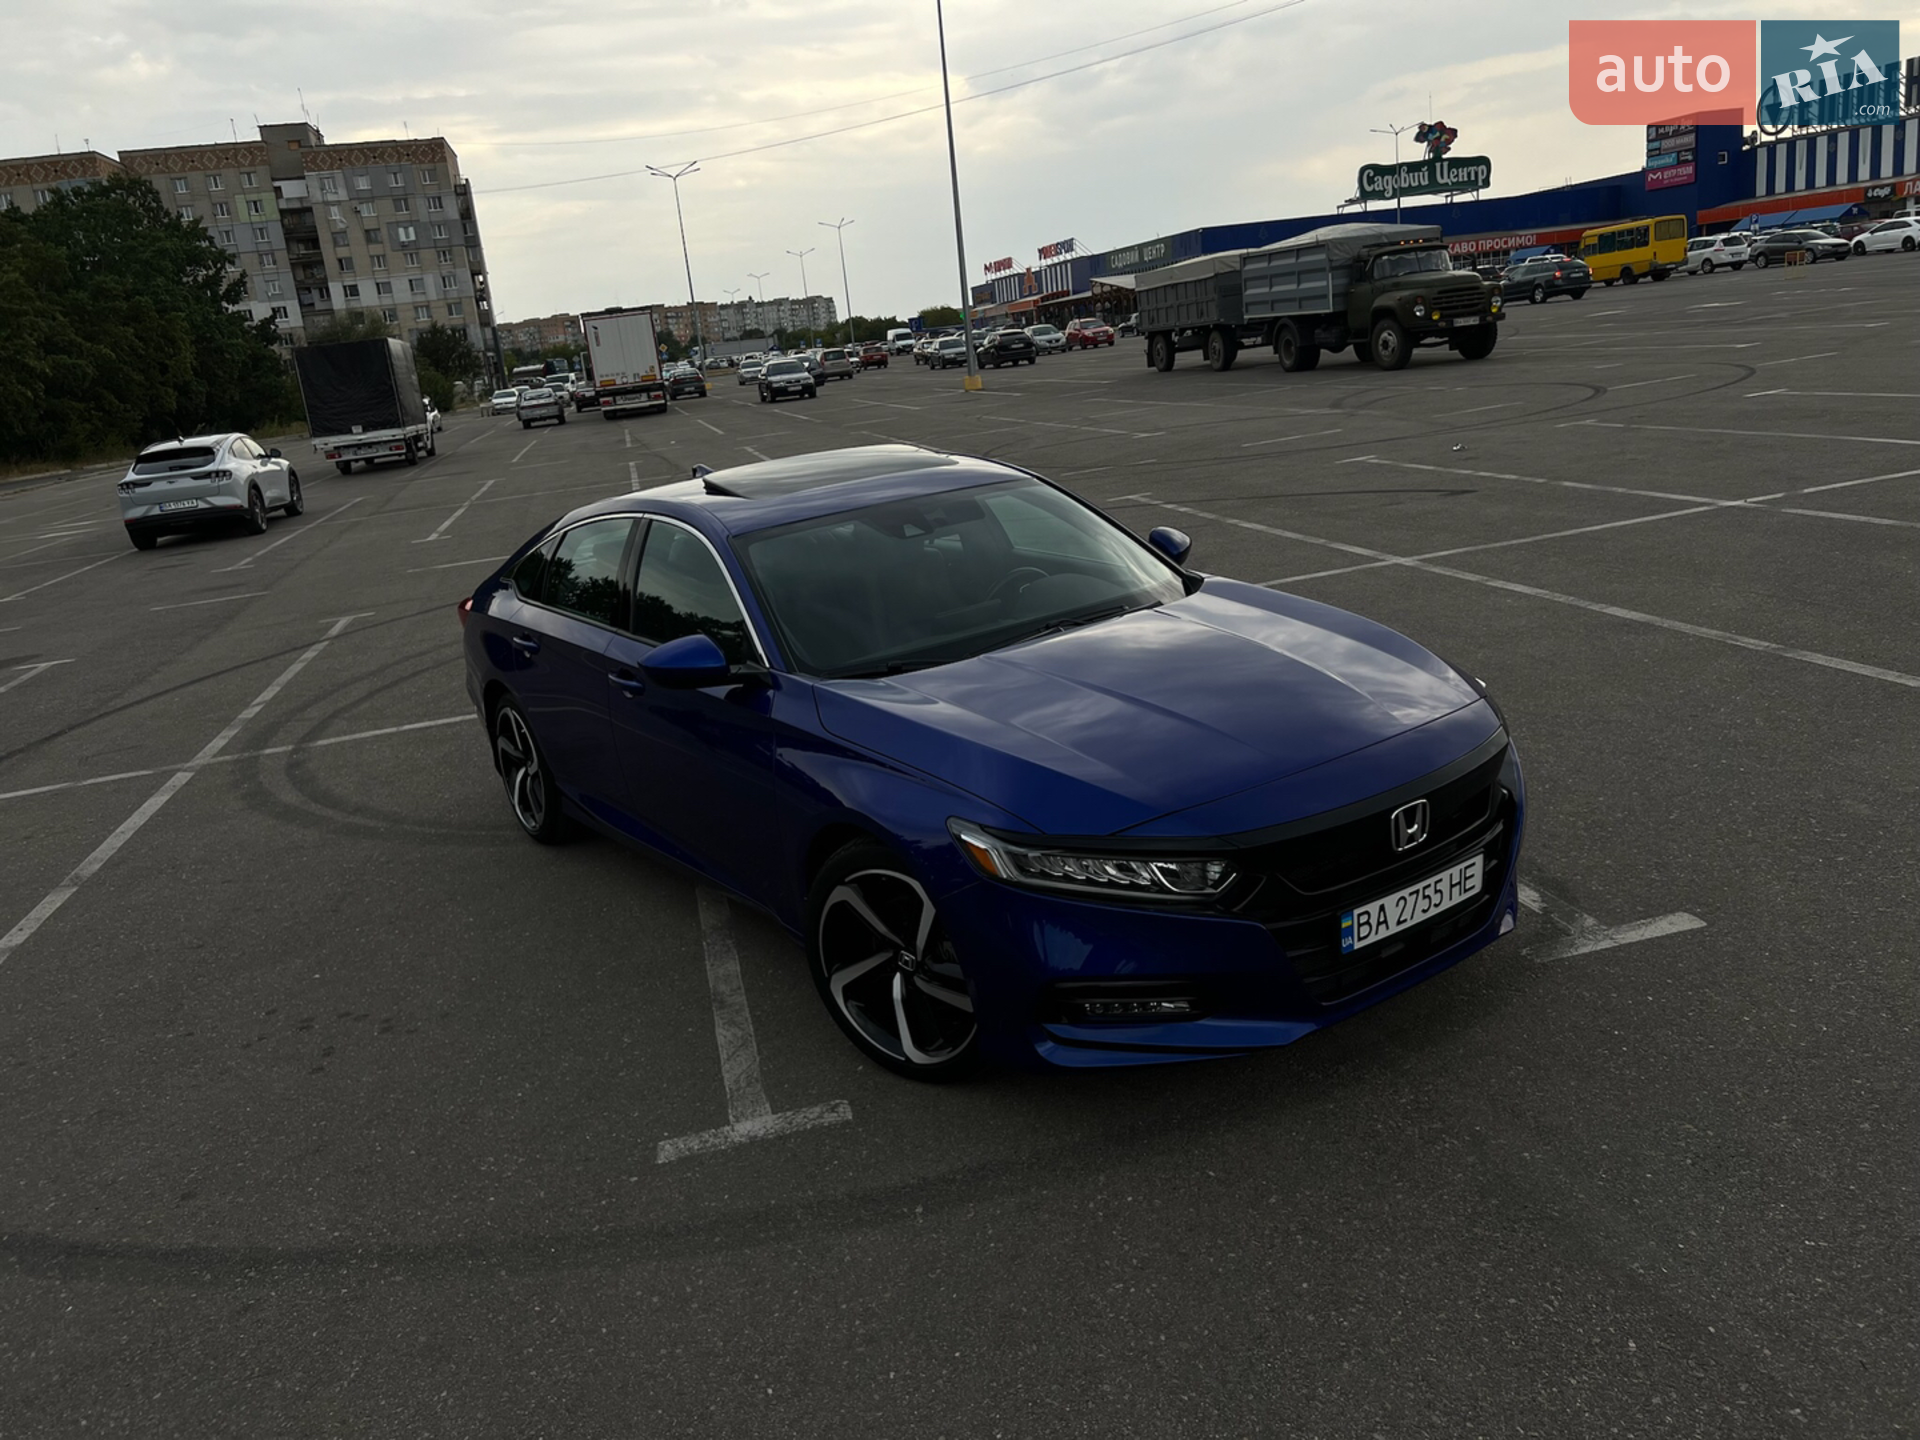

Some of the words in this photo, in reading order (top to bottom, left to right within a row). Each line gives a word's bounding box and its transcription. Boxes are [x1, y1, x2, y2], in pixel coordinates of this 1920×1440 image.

[1362, 165, 1429, 198] Садовий
[1435, 161, 1487, 186] Центр
[1110, 247, 1140, 269] САДОВИЙ
[1142, 243, 1166, 263] ЦЕНТР
[1478, 235, 1537, 251] ПРОСИМО!
[1356, 903, 1390, 943] BA
[1395, 878, 1444, 926] 2755
[1449, 861, 1477, 902] HE
[1341, 936, 1354, 948] UA
